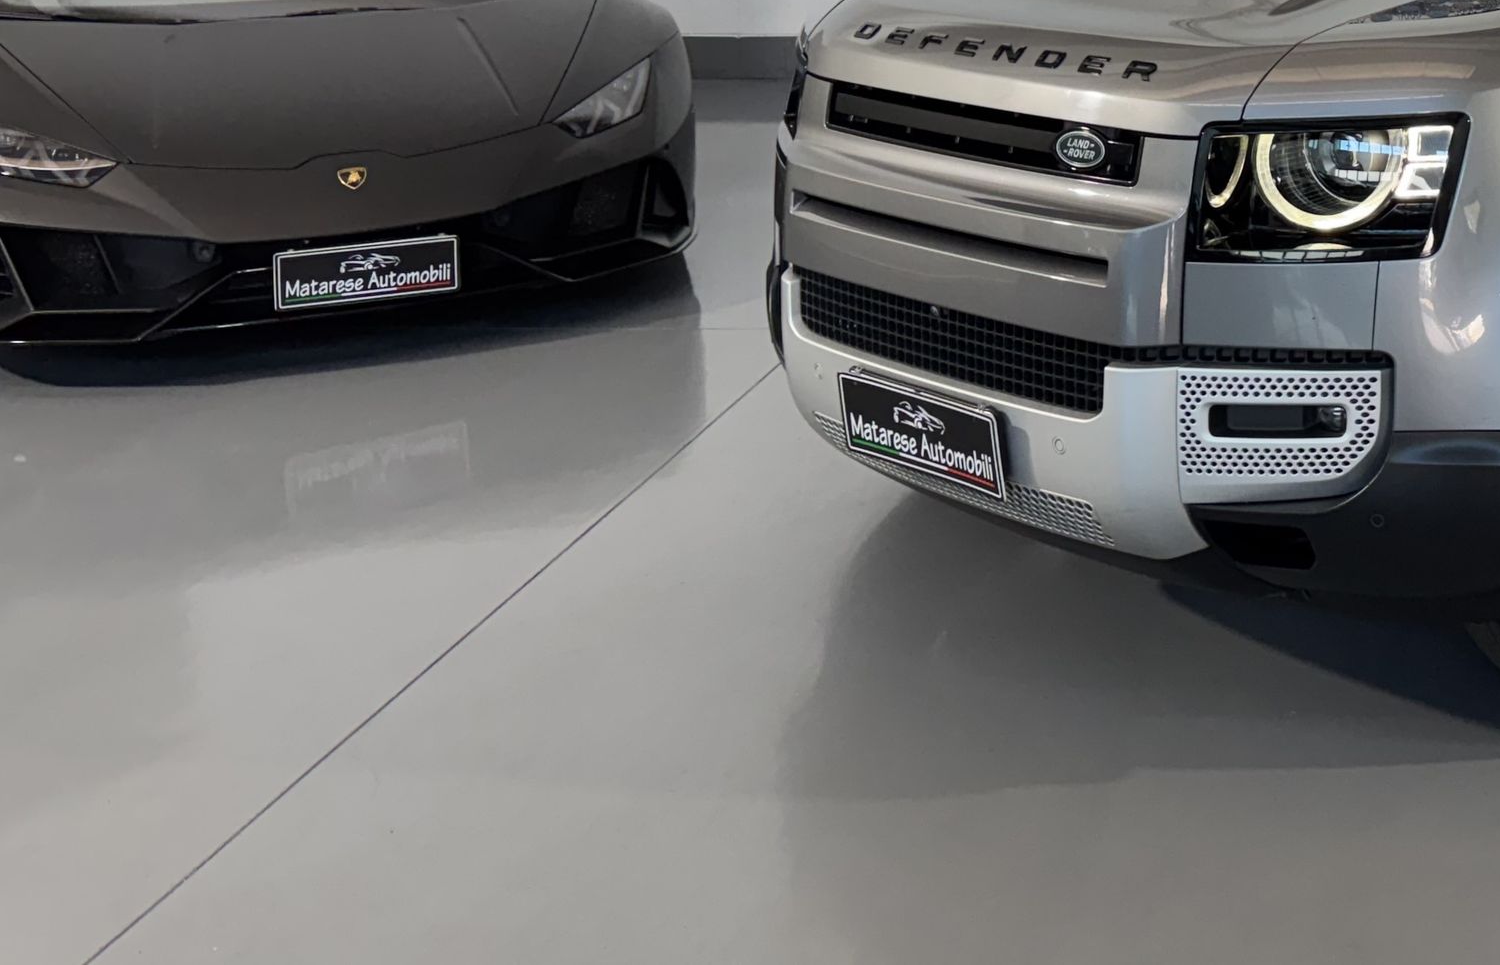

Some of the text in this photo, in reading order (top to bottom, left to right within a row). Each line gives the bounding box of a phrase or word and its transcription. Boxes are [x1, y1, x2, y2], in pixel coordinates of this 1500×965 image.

[853, 22, 1158, 83] DEFENDER
[285, 263, 451, 299] Matarese Automobili
[850, 412, 994, 482] Matarese Automobili
